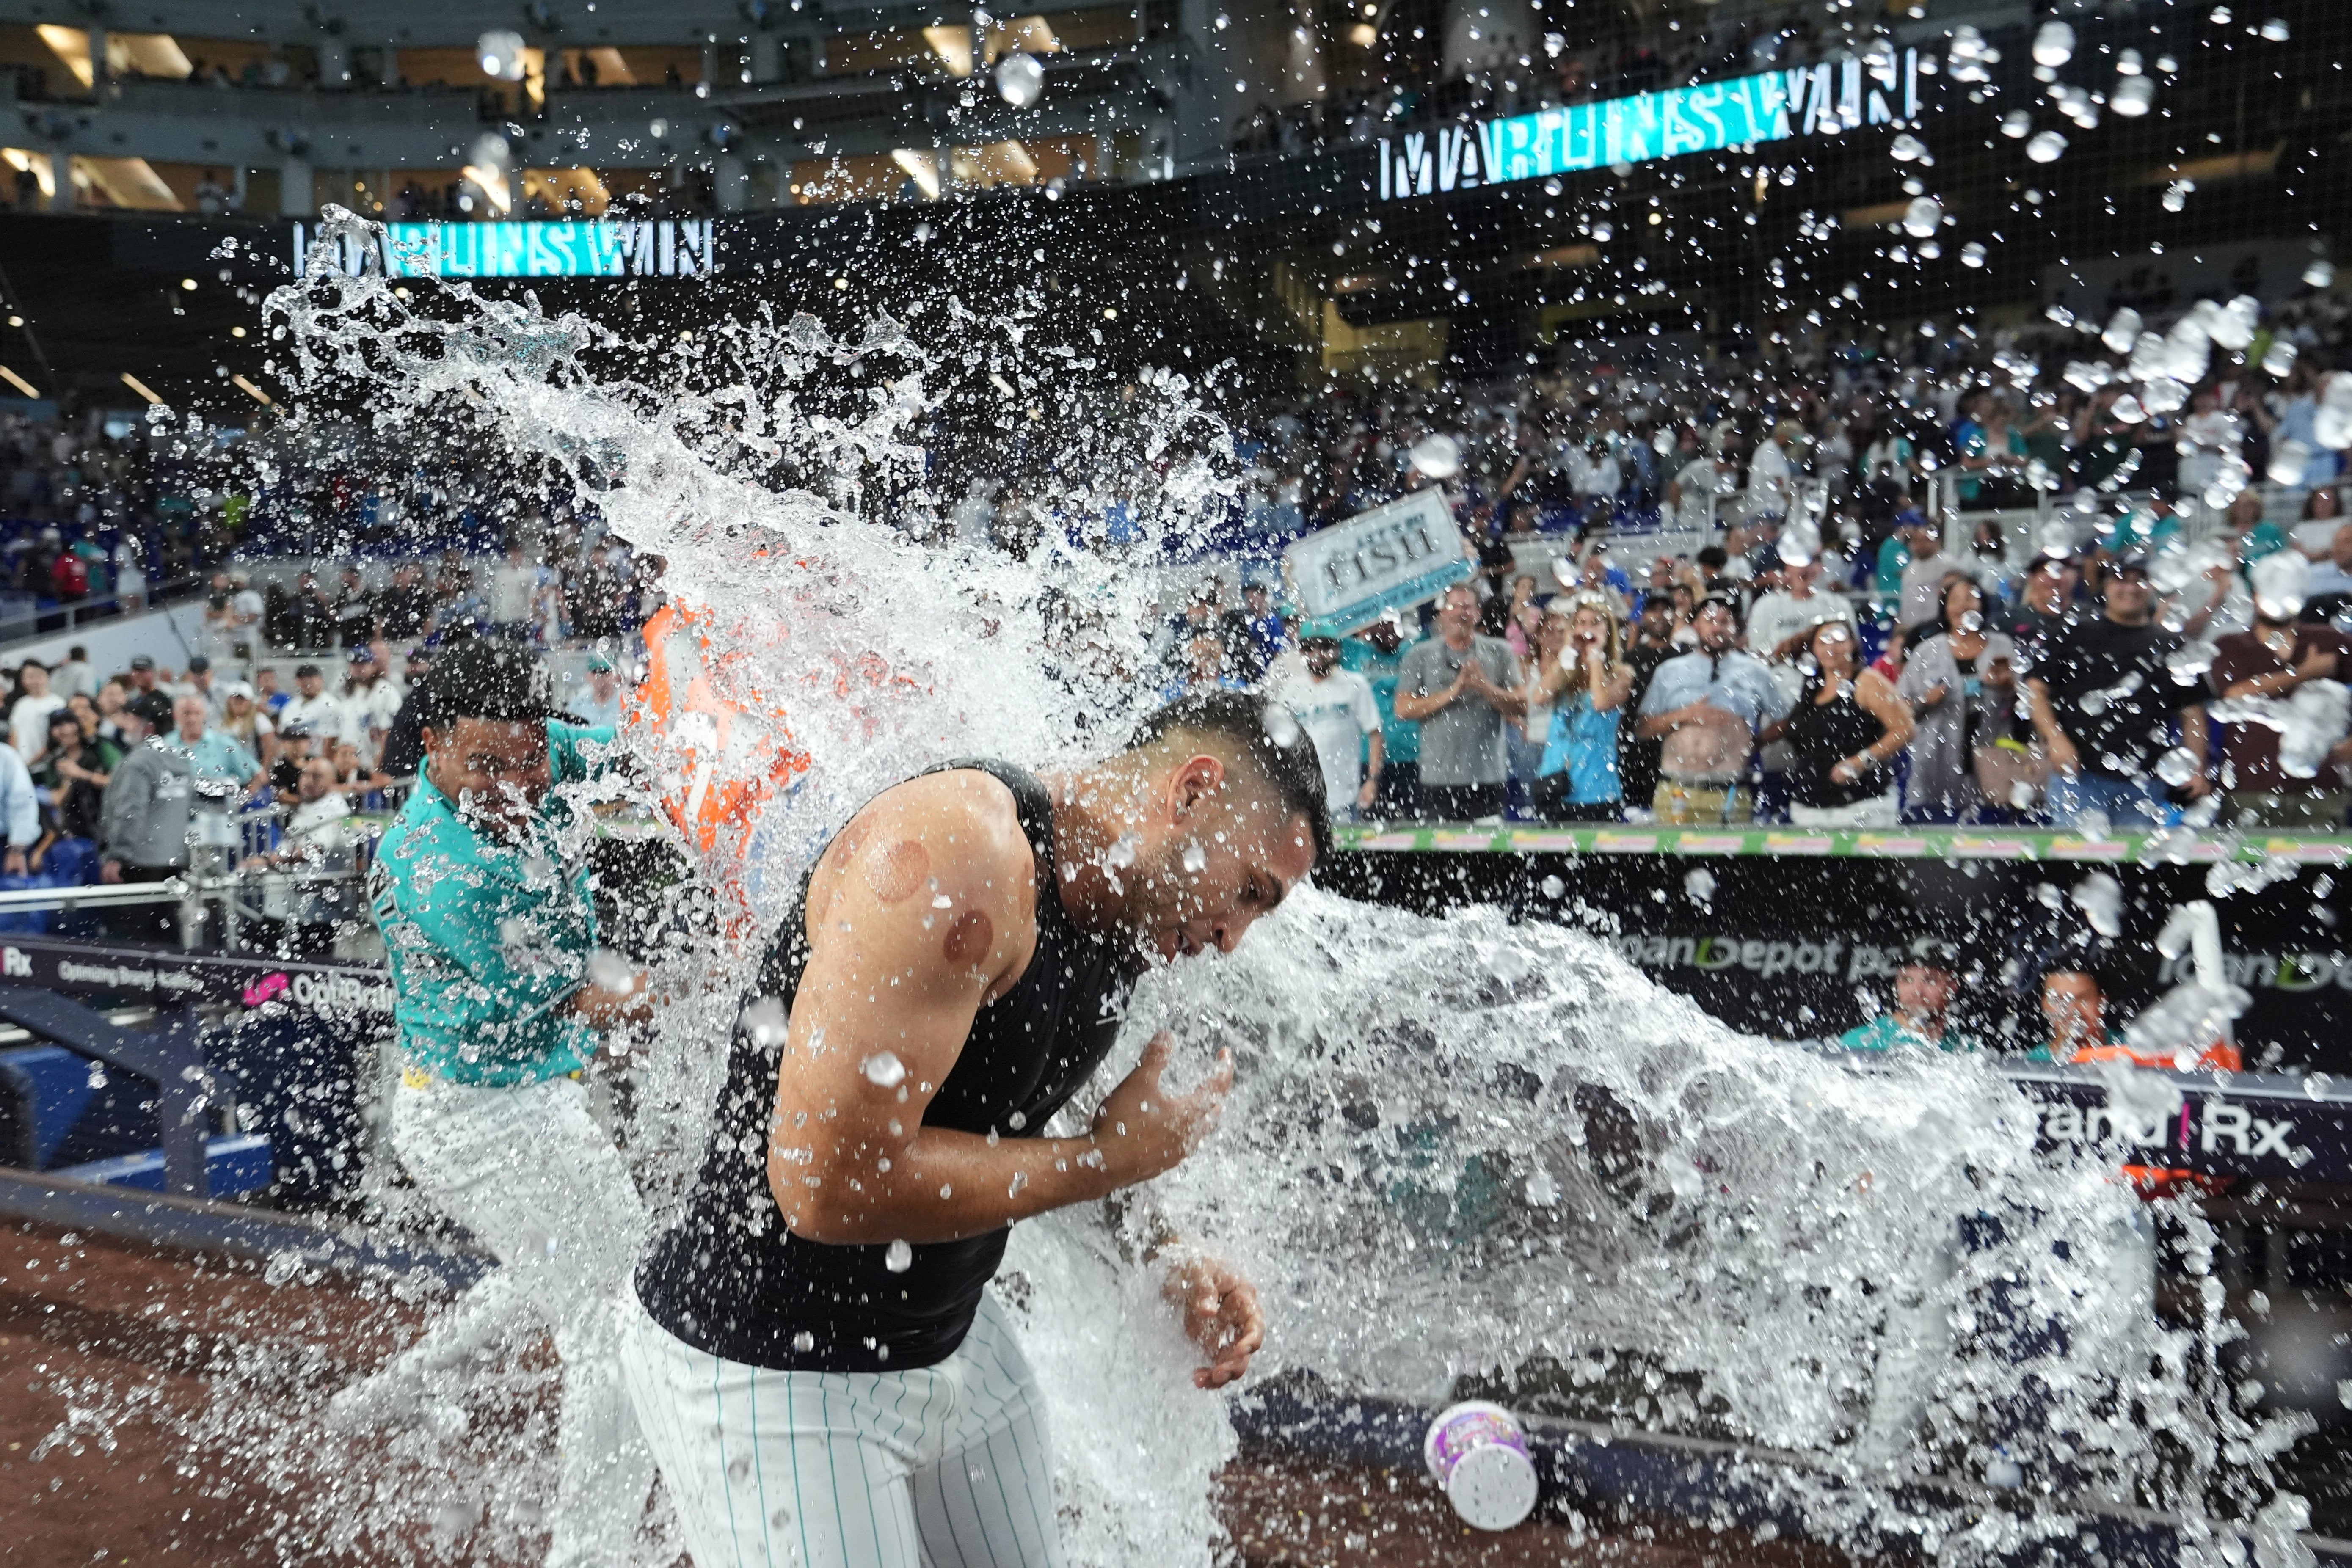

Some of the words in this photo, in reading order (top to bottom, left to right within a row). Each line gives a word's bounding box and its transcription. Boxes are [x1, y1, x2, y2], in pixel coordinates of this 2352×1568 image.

[1380, 83, 1724, 200] MARLINS
[1741, 47, 1916, 139] WIN
[585, 220, 713, 276] WIN
[1323, 528, 1439, 589] FISH
[3, 946, 33, 977] Rx
[2202, 1104, 2294, 1158] Rx
